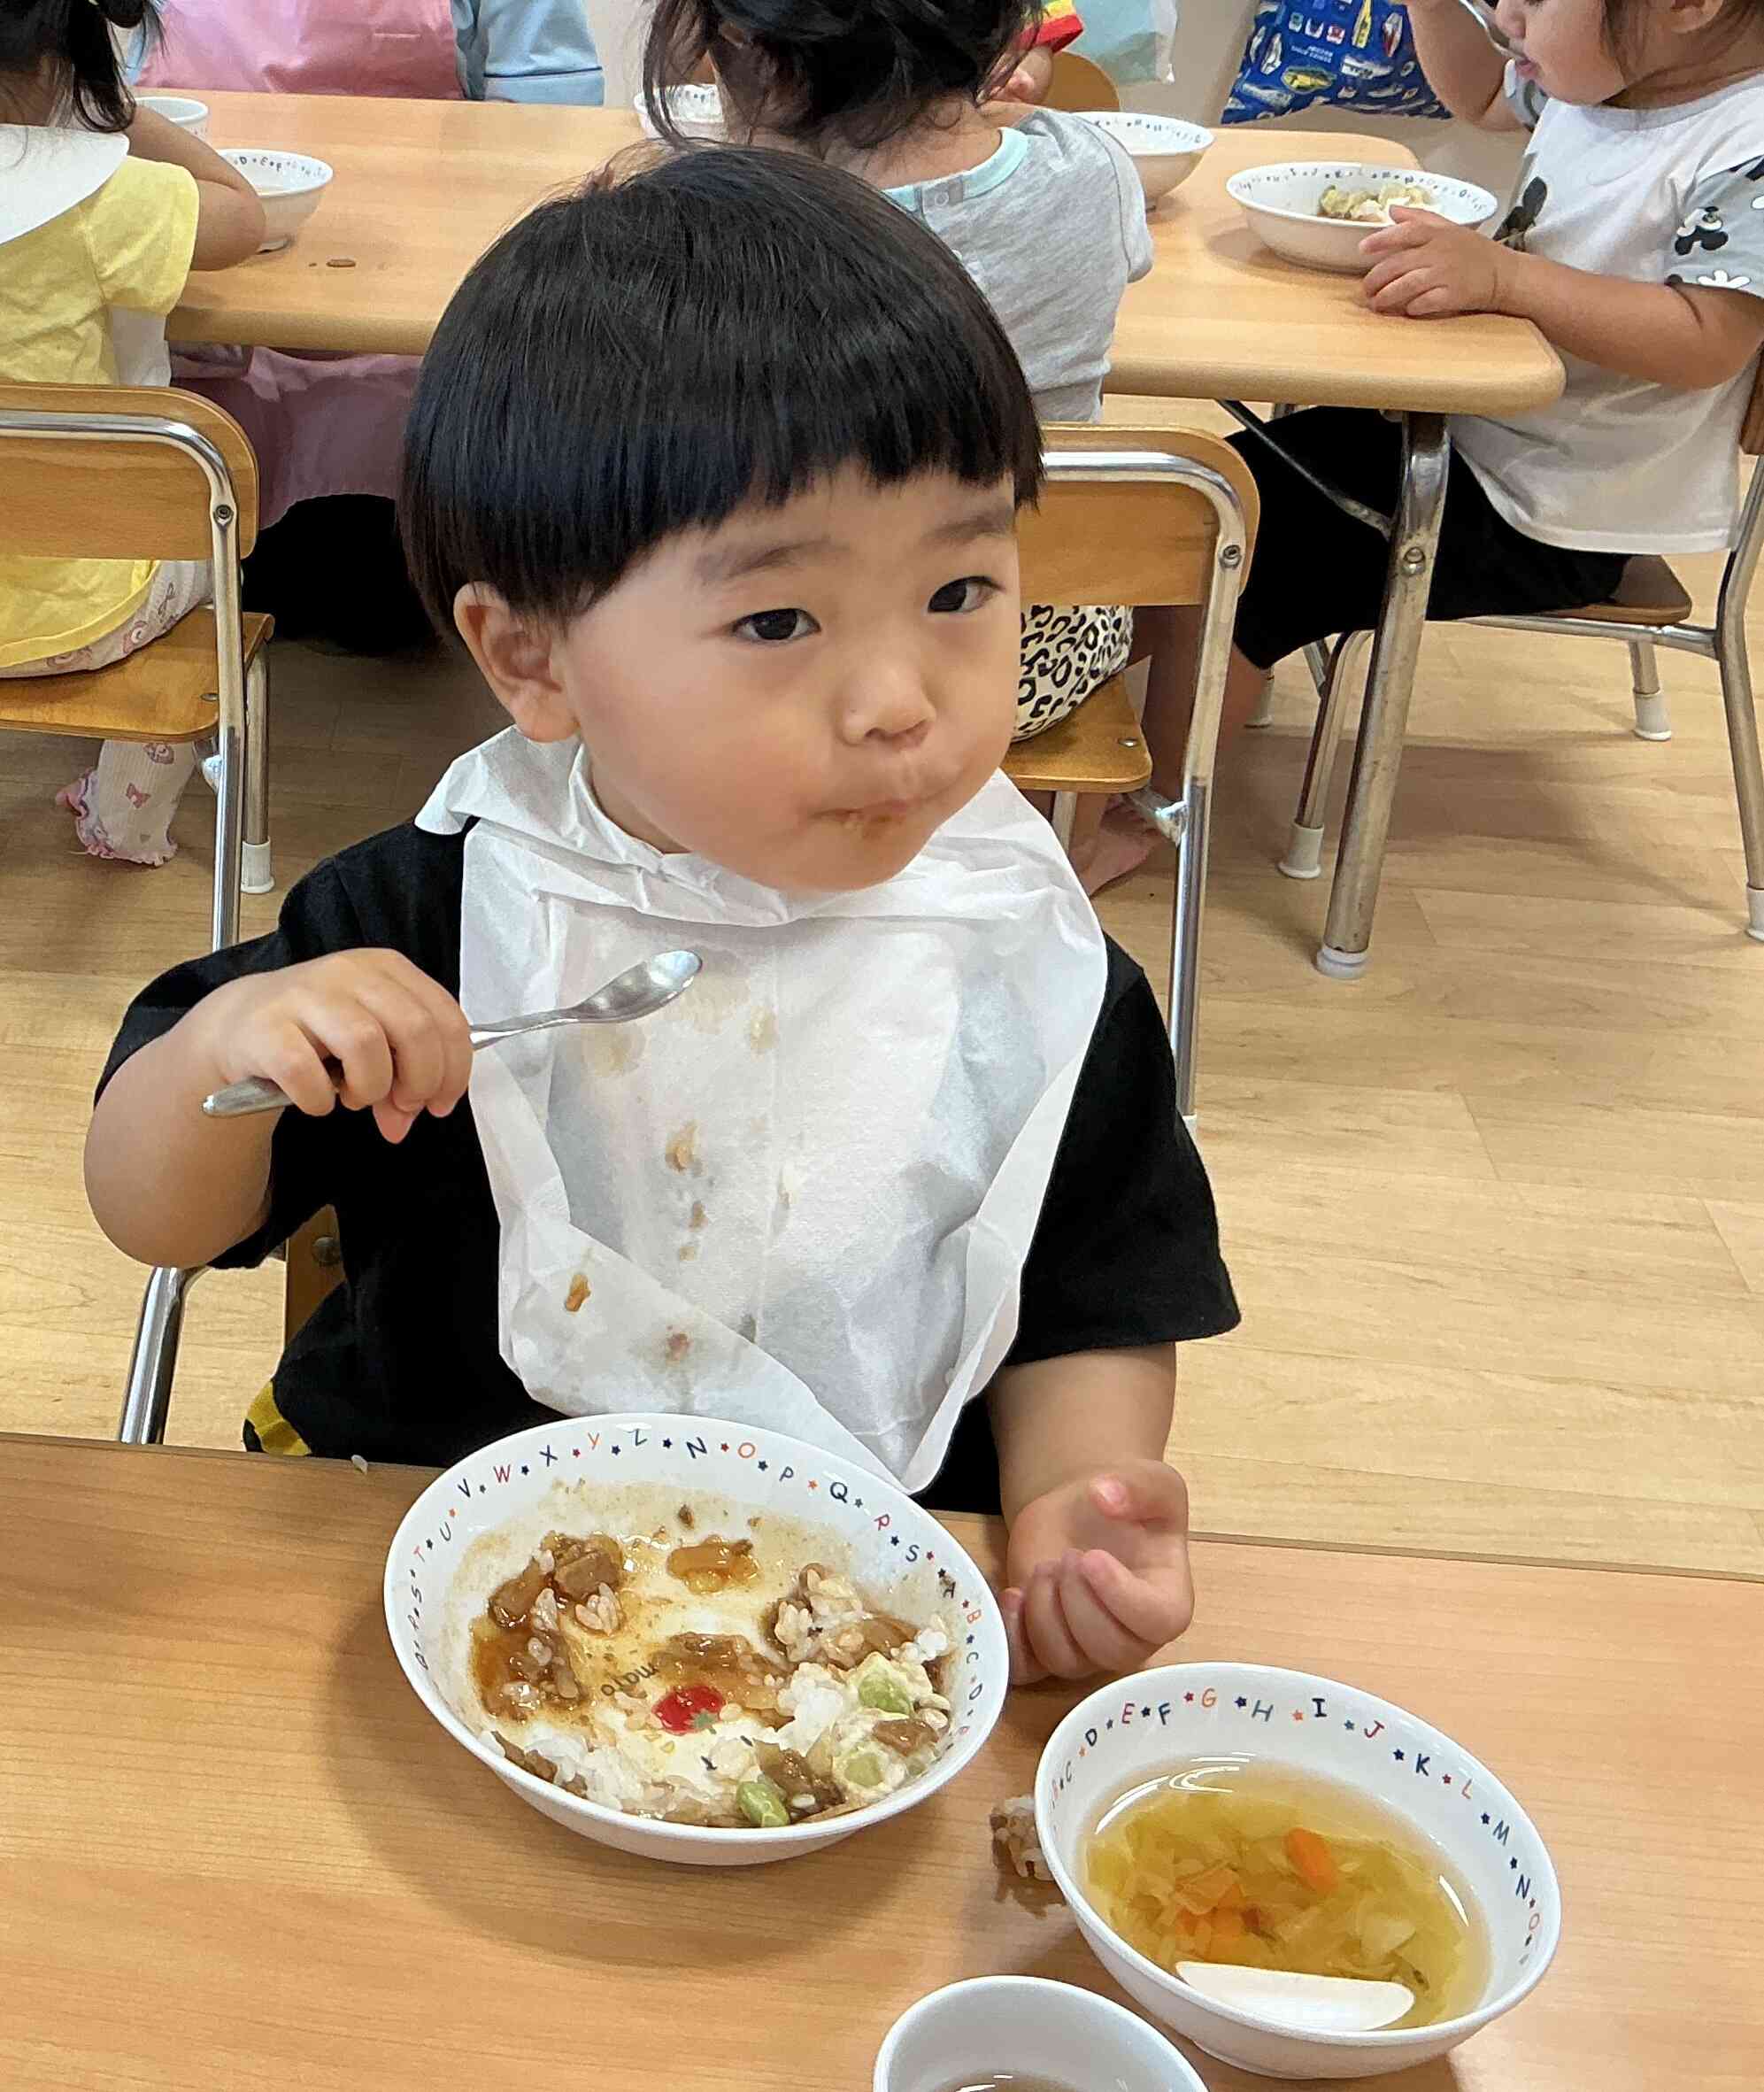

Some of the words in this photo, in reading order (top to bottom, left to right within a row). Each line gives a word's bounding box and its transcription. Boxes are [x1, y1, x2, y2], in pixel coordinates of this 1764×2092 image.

[588, 1432, 600, 1449] Y
[627, 1428, 648, 1446] Z
[539, 1445, 558, 1467] X
[686, 1437, 707, 1459] N
[737, 1442, 756, 1458] O
[493, 1464, 511, 1483] W
[779, 1466, 794, 1481] P
[457, 1478, 471, 1498] V
[829, 1481, 848, 1503] Q
[439, 1522, 451, 1541] U
[873, 1514, 890, 1531] R
[413, 1546, 425, 1563] T
[905, 1544, 920, 1563] S
[967, 1610, 982, 1625] B
[966, 1651, 979, 1664] C
[1085, 1728, 1098, 1747] D
[1121, 1702, 1136, 1725] E
[1158, 1702, 1171, 1725] F
[1202, 1687, 1217, 1708] G
[1252, 1699, 1274, 1723] H
[1312, 1697, 1328, 1718] I
[1364, 1719, 1385, 1738] J
[1415, 1753, 1430, 1777] K
[1461, 1779, 1473, 1800] L
[1492, 1819, 1510, 1847] M
[1515, 1873, 1531, 1900] N
[1529, 1912, 1542, 1932] O
